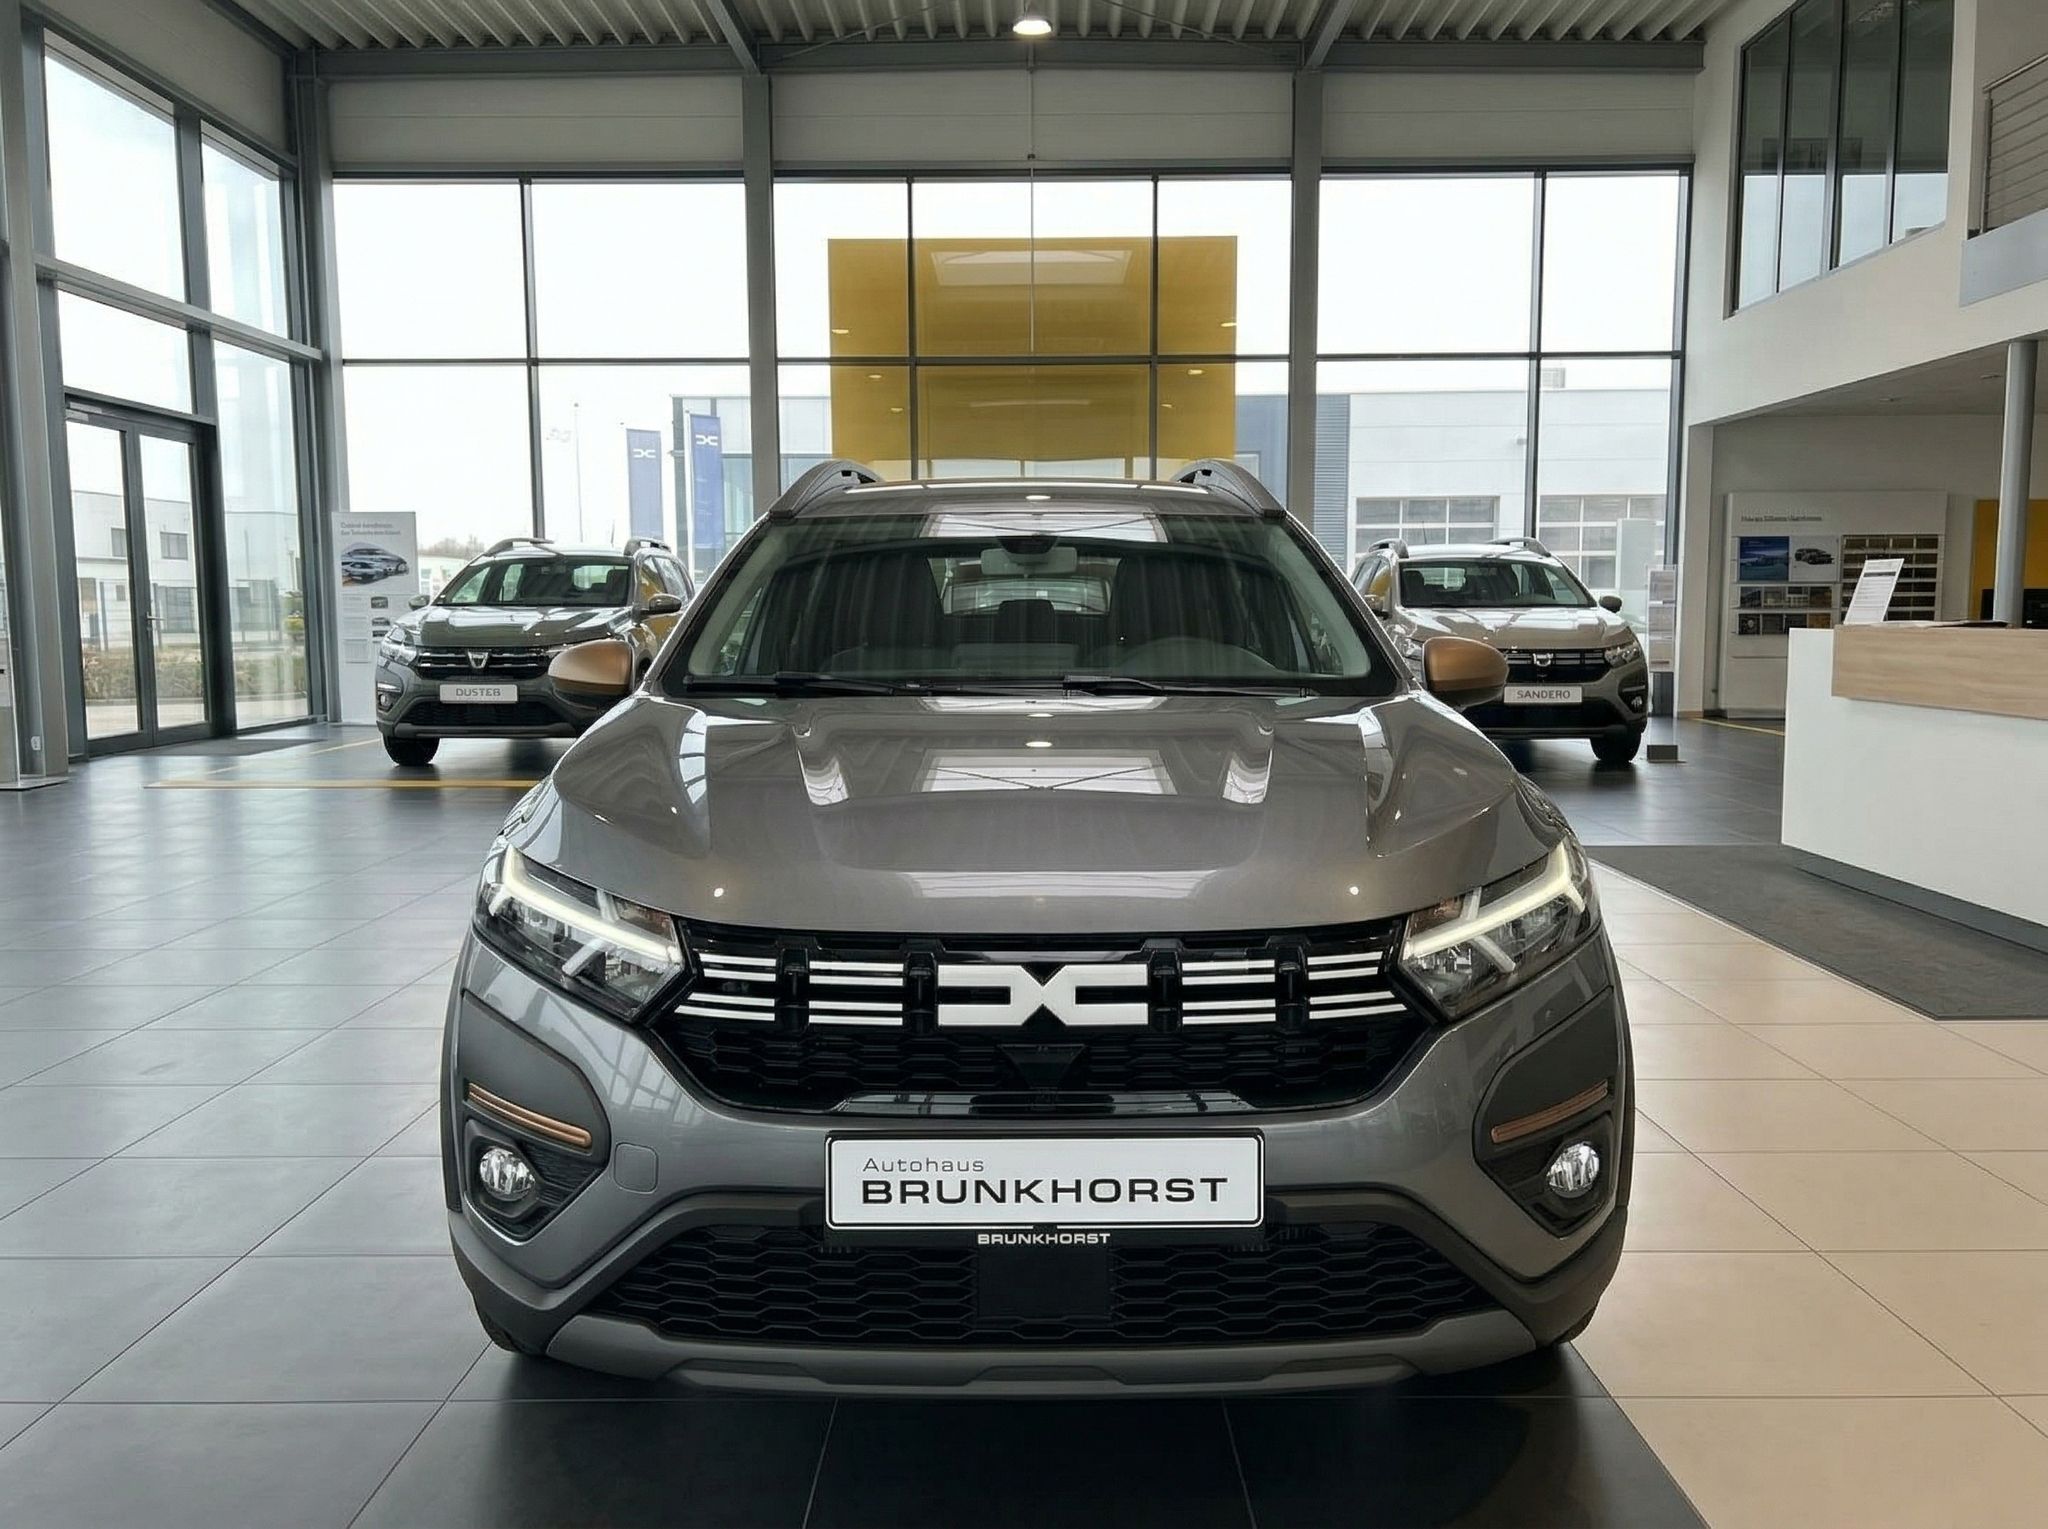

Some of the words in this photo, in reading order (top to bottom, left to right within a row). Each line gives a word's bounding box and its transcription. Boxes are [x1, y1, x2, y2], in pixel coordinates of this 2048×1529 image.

[1516, 690, 1571, 699] SANDERO
[862, 1157, 985, 1173] Autohaus
[862, 1177, 1228, 1204] BRUNKHORST
[977, 1232, 1111, 1245] BRUNKHORST
